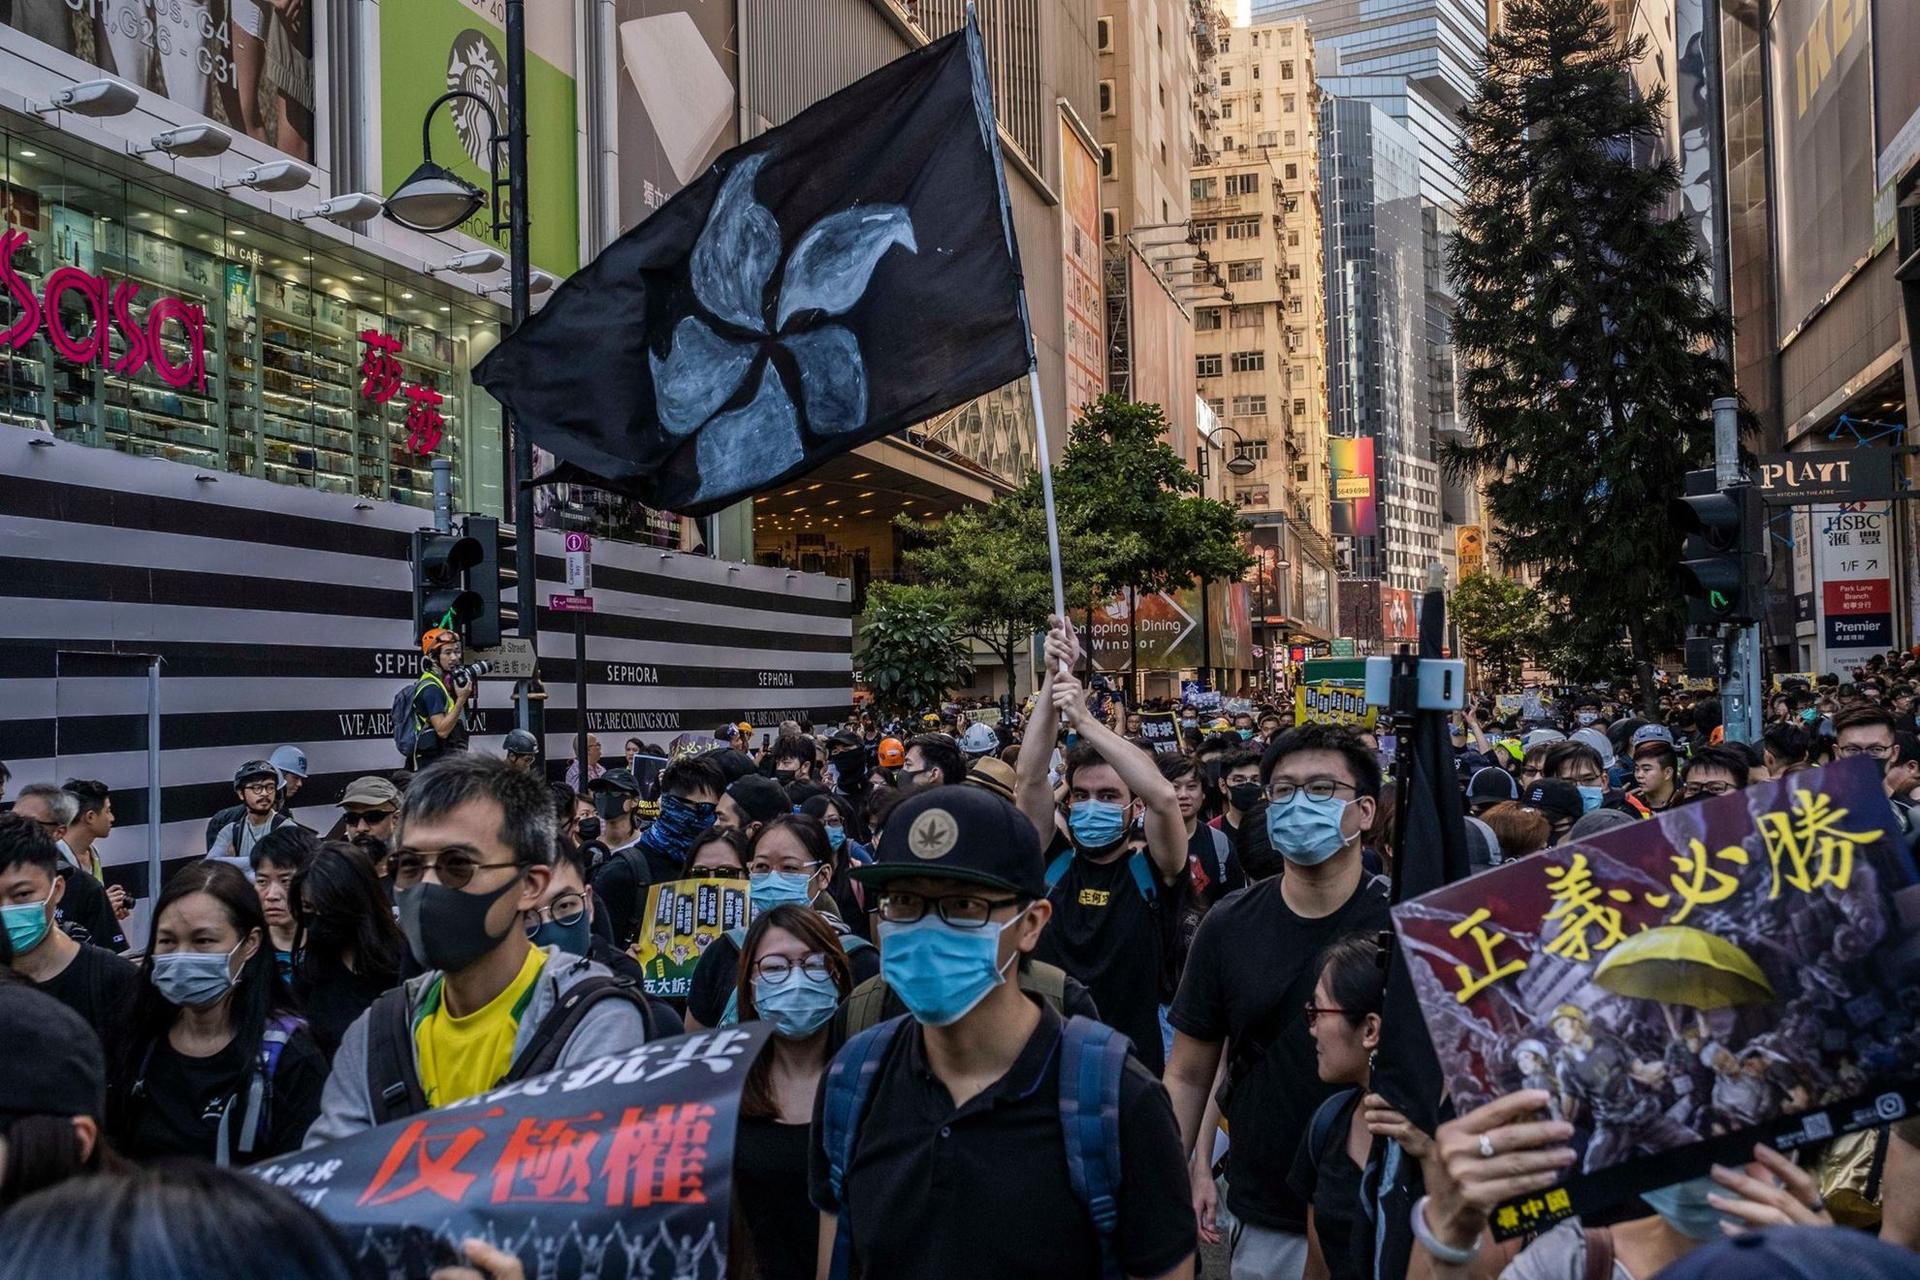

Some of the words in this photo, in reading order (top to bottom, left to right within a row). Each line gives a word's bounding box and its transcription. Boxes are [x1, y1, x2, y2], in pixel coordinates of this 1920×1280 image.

[197, 9, 230, 48] G4
[196, 45, 238, 90] G31
[213, 239, 237, 257] SKIN
[239, 248, 264, 266] CARE
[358, 329, 444, 456] 莎莎
[1760, 460, 1850, 489] PLAYT
[1827, 513, 1880, 532] HSBC
[1840, 560, 1859, 573] 1/F
[1840, 585, 1854, 593] Park
[1856, 584, 1874, 592] Lane
[1845, 592, 1870, 601] Branch
[1073, 621, 1128, 637] Shpping
[1141, 619, 1181, 634] Dining
[1835, 621, 1881, 633] Premier
[607, 665, 658, 684] SEPHORA
[758, 672, 794, 687] SEPHORA
[339, 714, 364, 736] WE
[366, 713, 393, 735] ARE
[586, 712, 602, 729] WE
[603, 712, 620, 729] ARE
[621, 712, 655, 729] COMING
[655, 712, 680, 729] SOON!
[1448, 788, 1884, 1004] 正義必勝
[357, 1104, 717, 1209] 反極權
